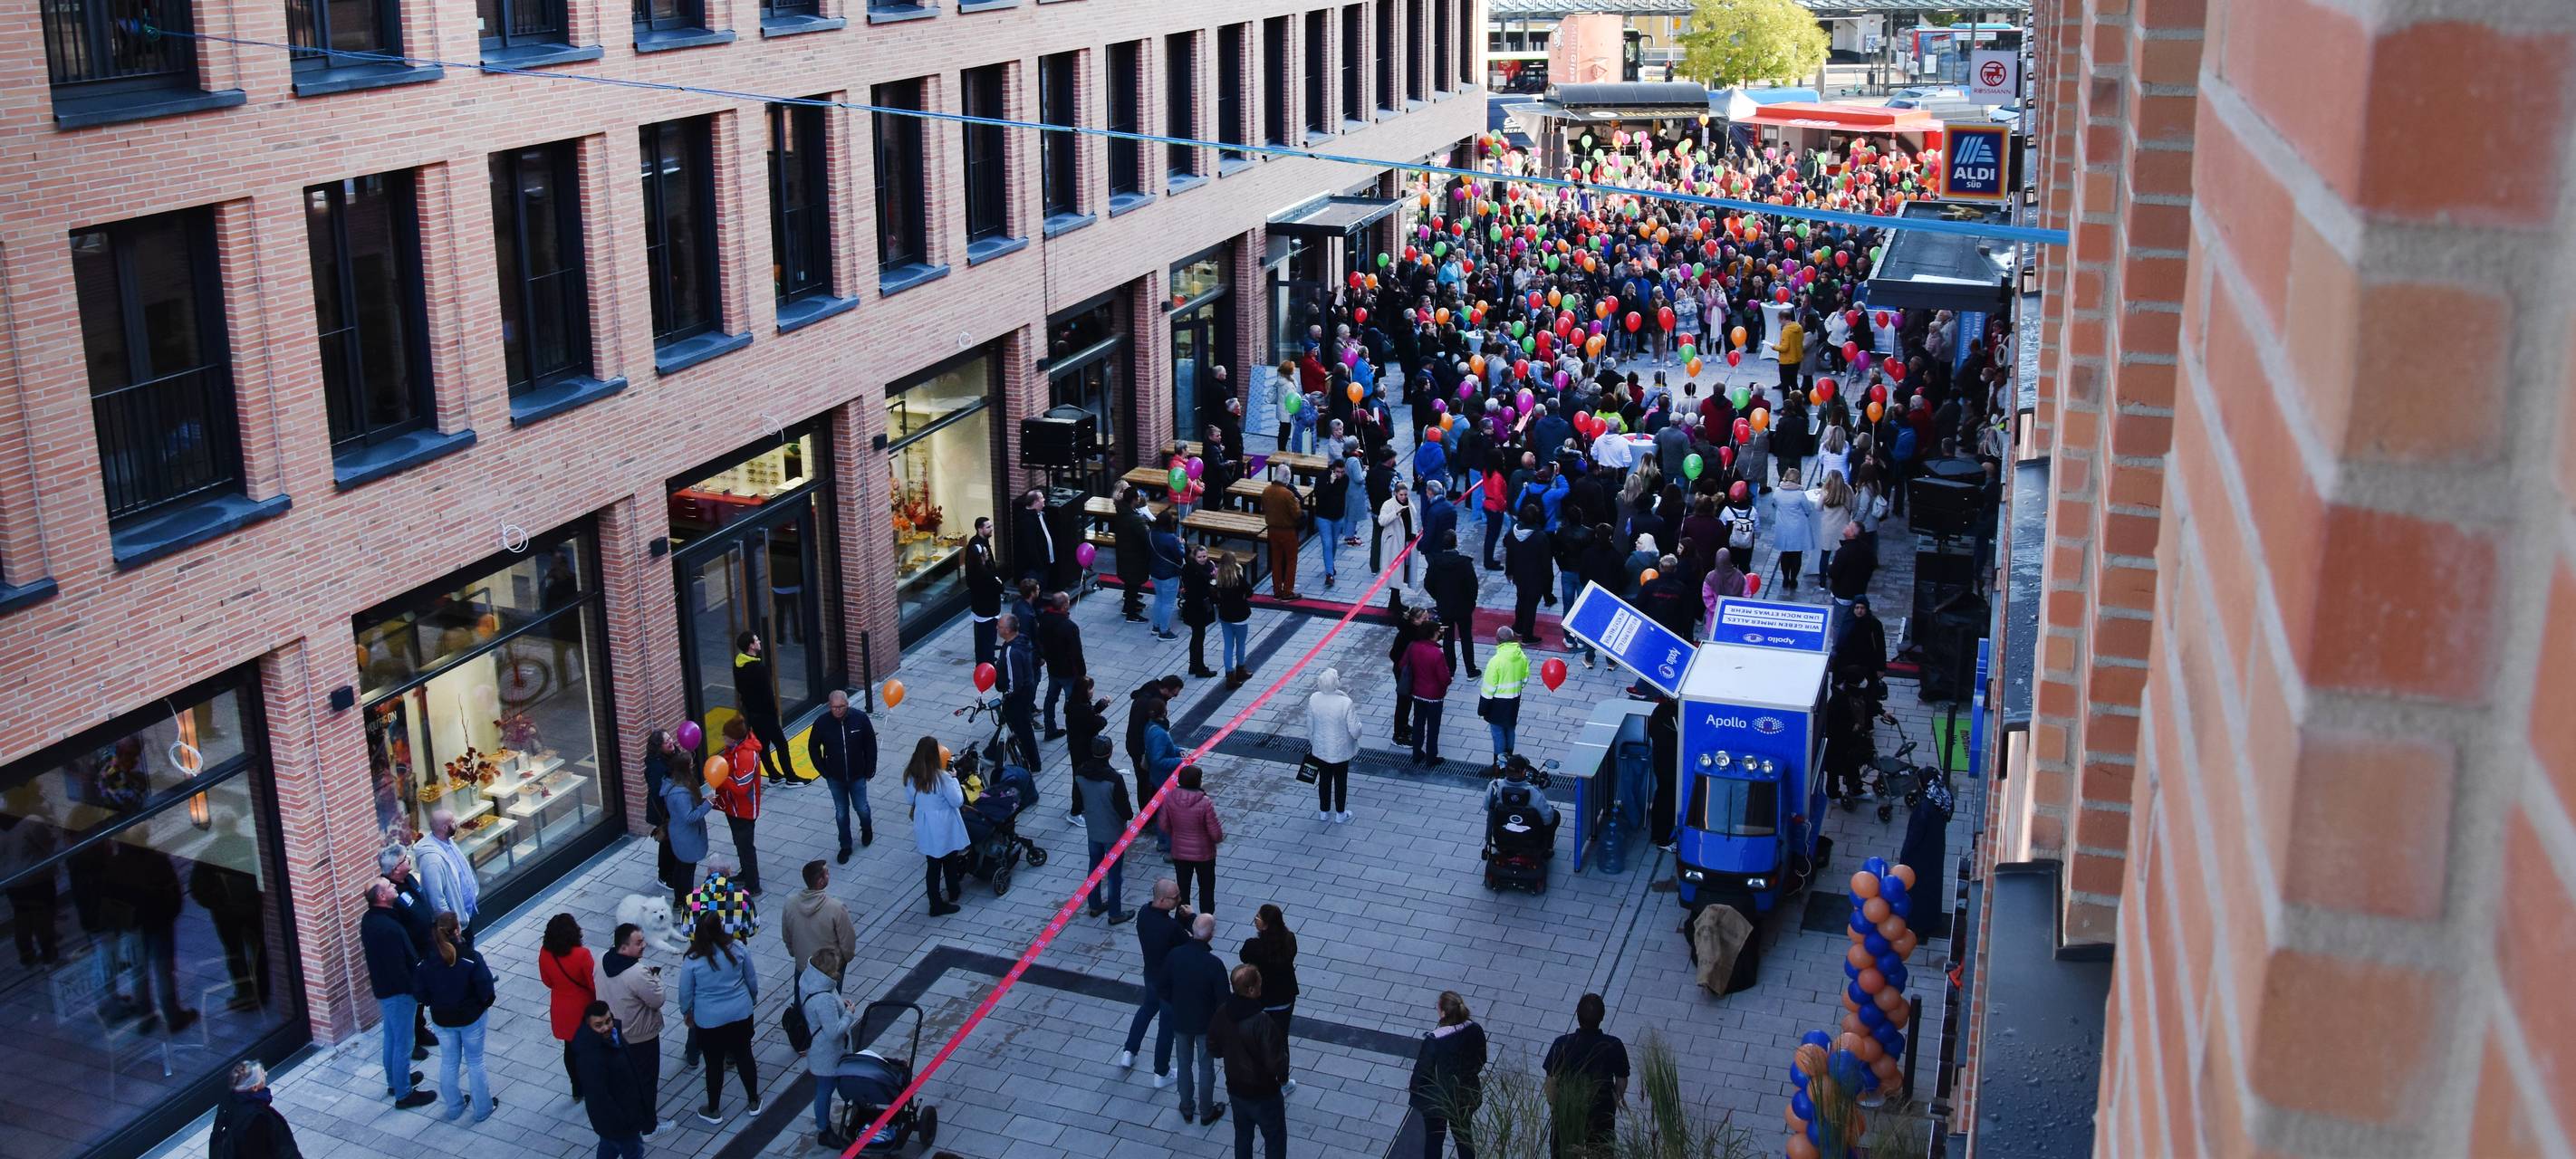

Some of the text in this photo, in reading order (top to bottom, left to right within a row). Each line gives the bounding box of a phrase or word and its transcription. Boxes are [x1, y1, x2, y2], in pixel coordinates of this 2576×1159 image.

[1954, 167, 1995, 181] ALDI
[1752, 618, 1776, 627] IMMER
[1767, 636, 1795, 645] Apollo
[1667, 647, 1681, 665] Apollo
[1706, 714, 1746, 729] Apollo
